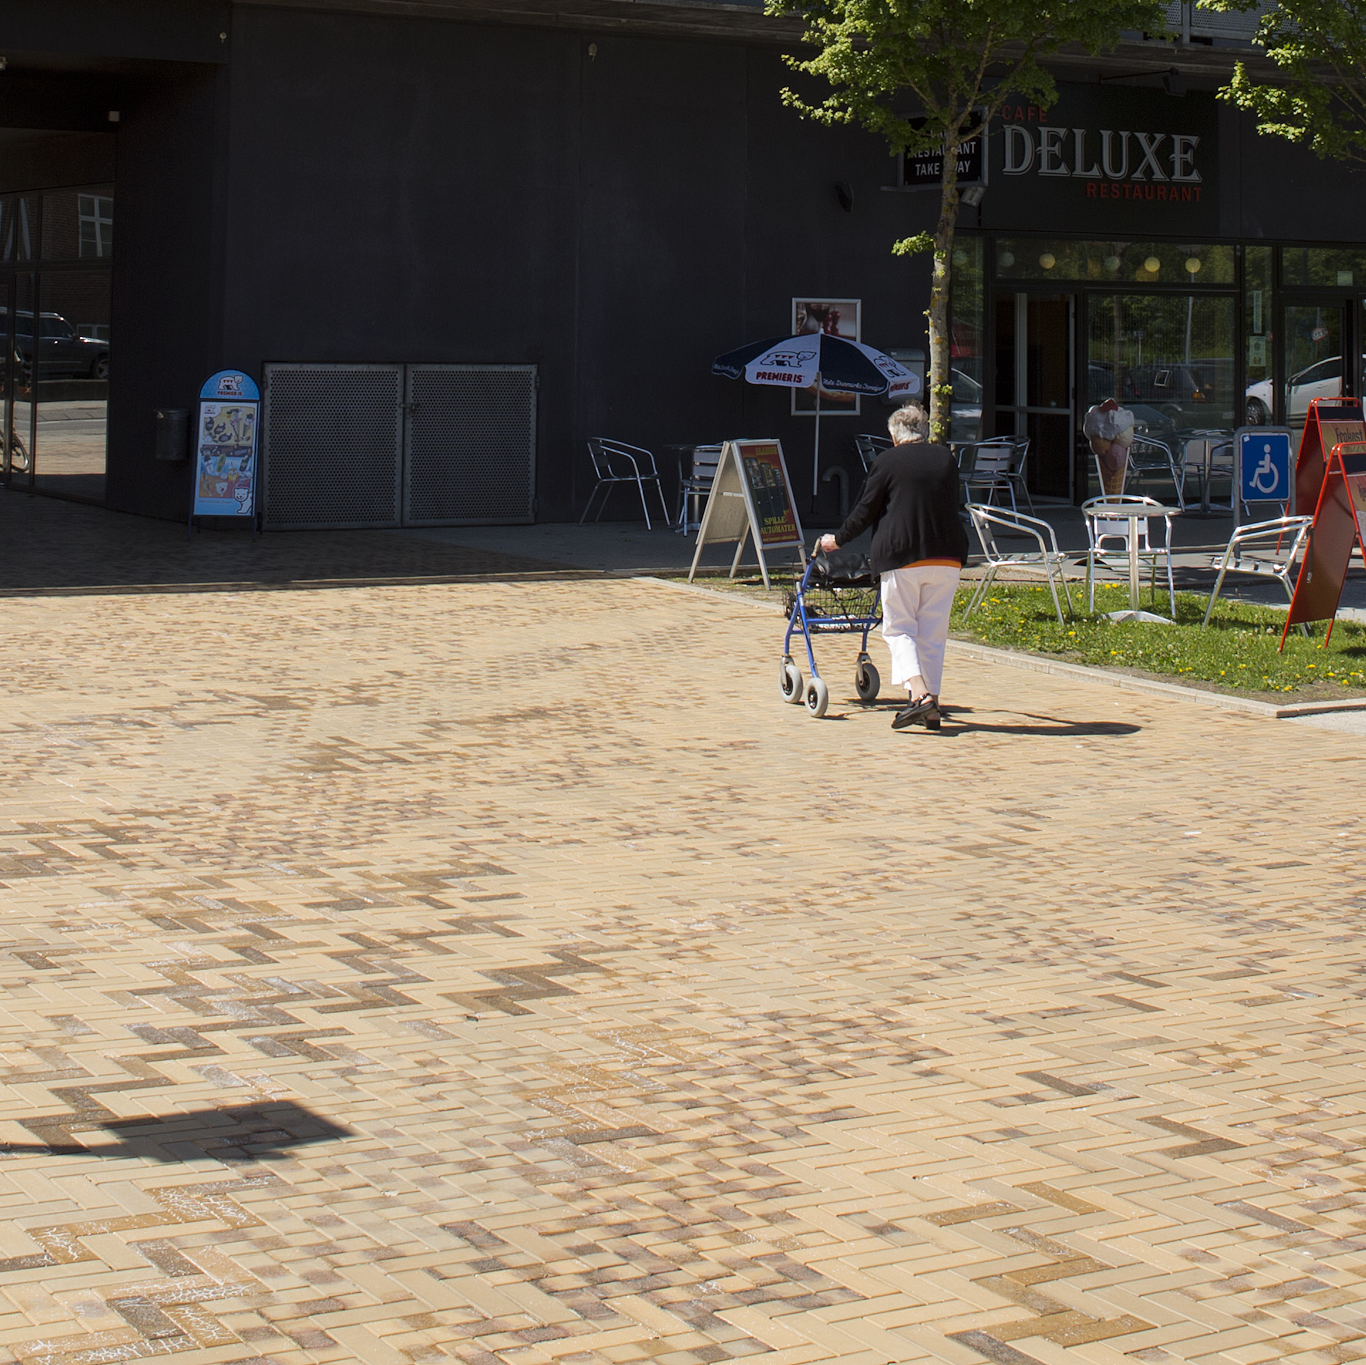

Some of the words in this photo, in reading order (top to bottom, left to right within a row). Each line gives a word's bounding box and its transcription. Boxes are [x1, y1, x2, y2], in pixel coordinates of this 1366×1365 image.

[1001, 105, 1048, 122] CAFE
[1001, 124, 1203, 183] DELUXE
[915, 162, 941, 176] TAKE
[1085, 182, 1203, 202] RESTAURANT
[756, 371, 792, 383] PREMIER
[760, 524, 796, 535] AUTOMATER
